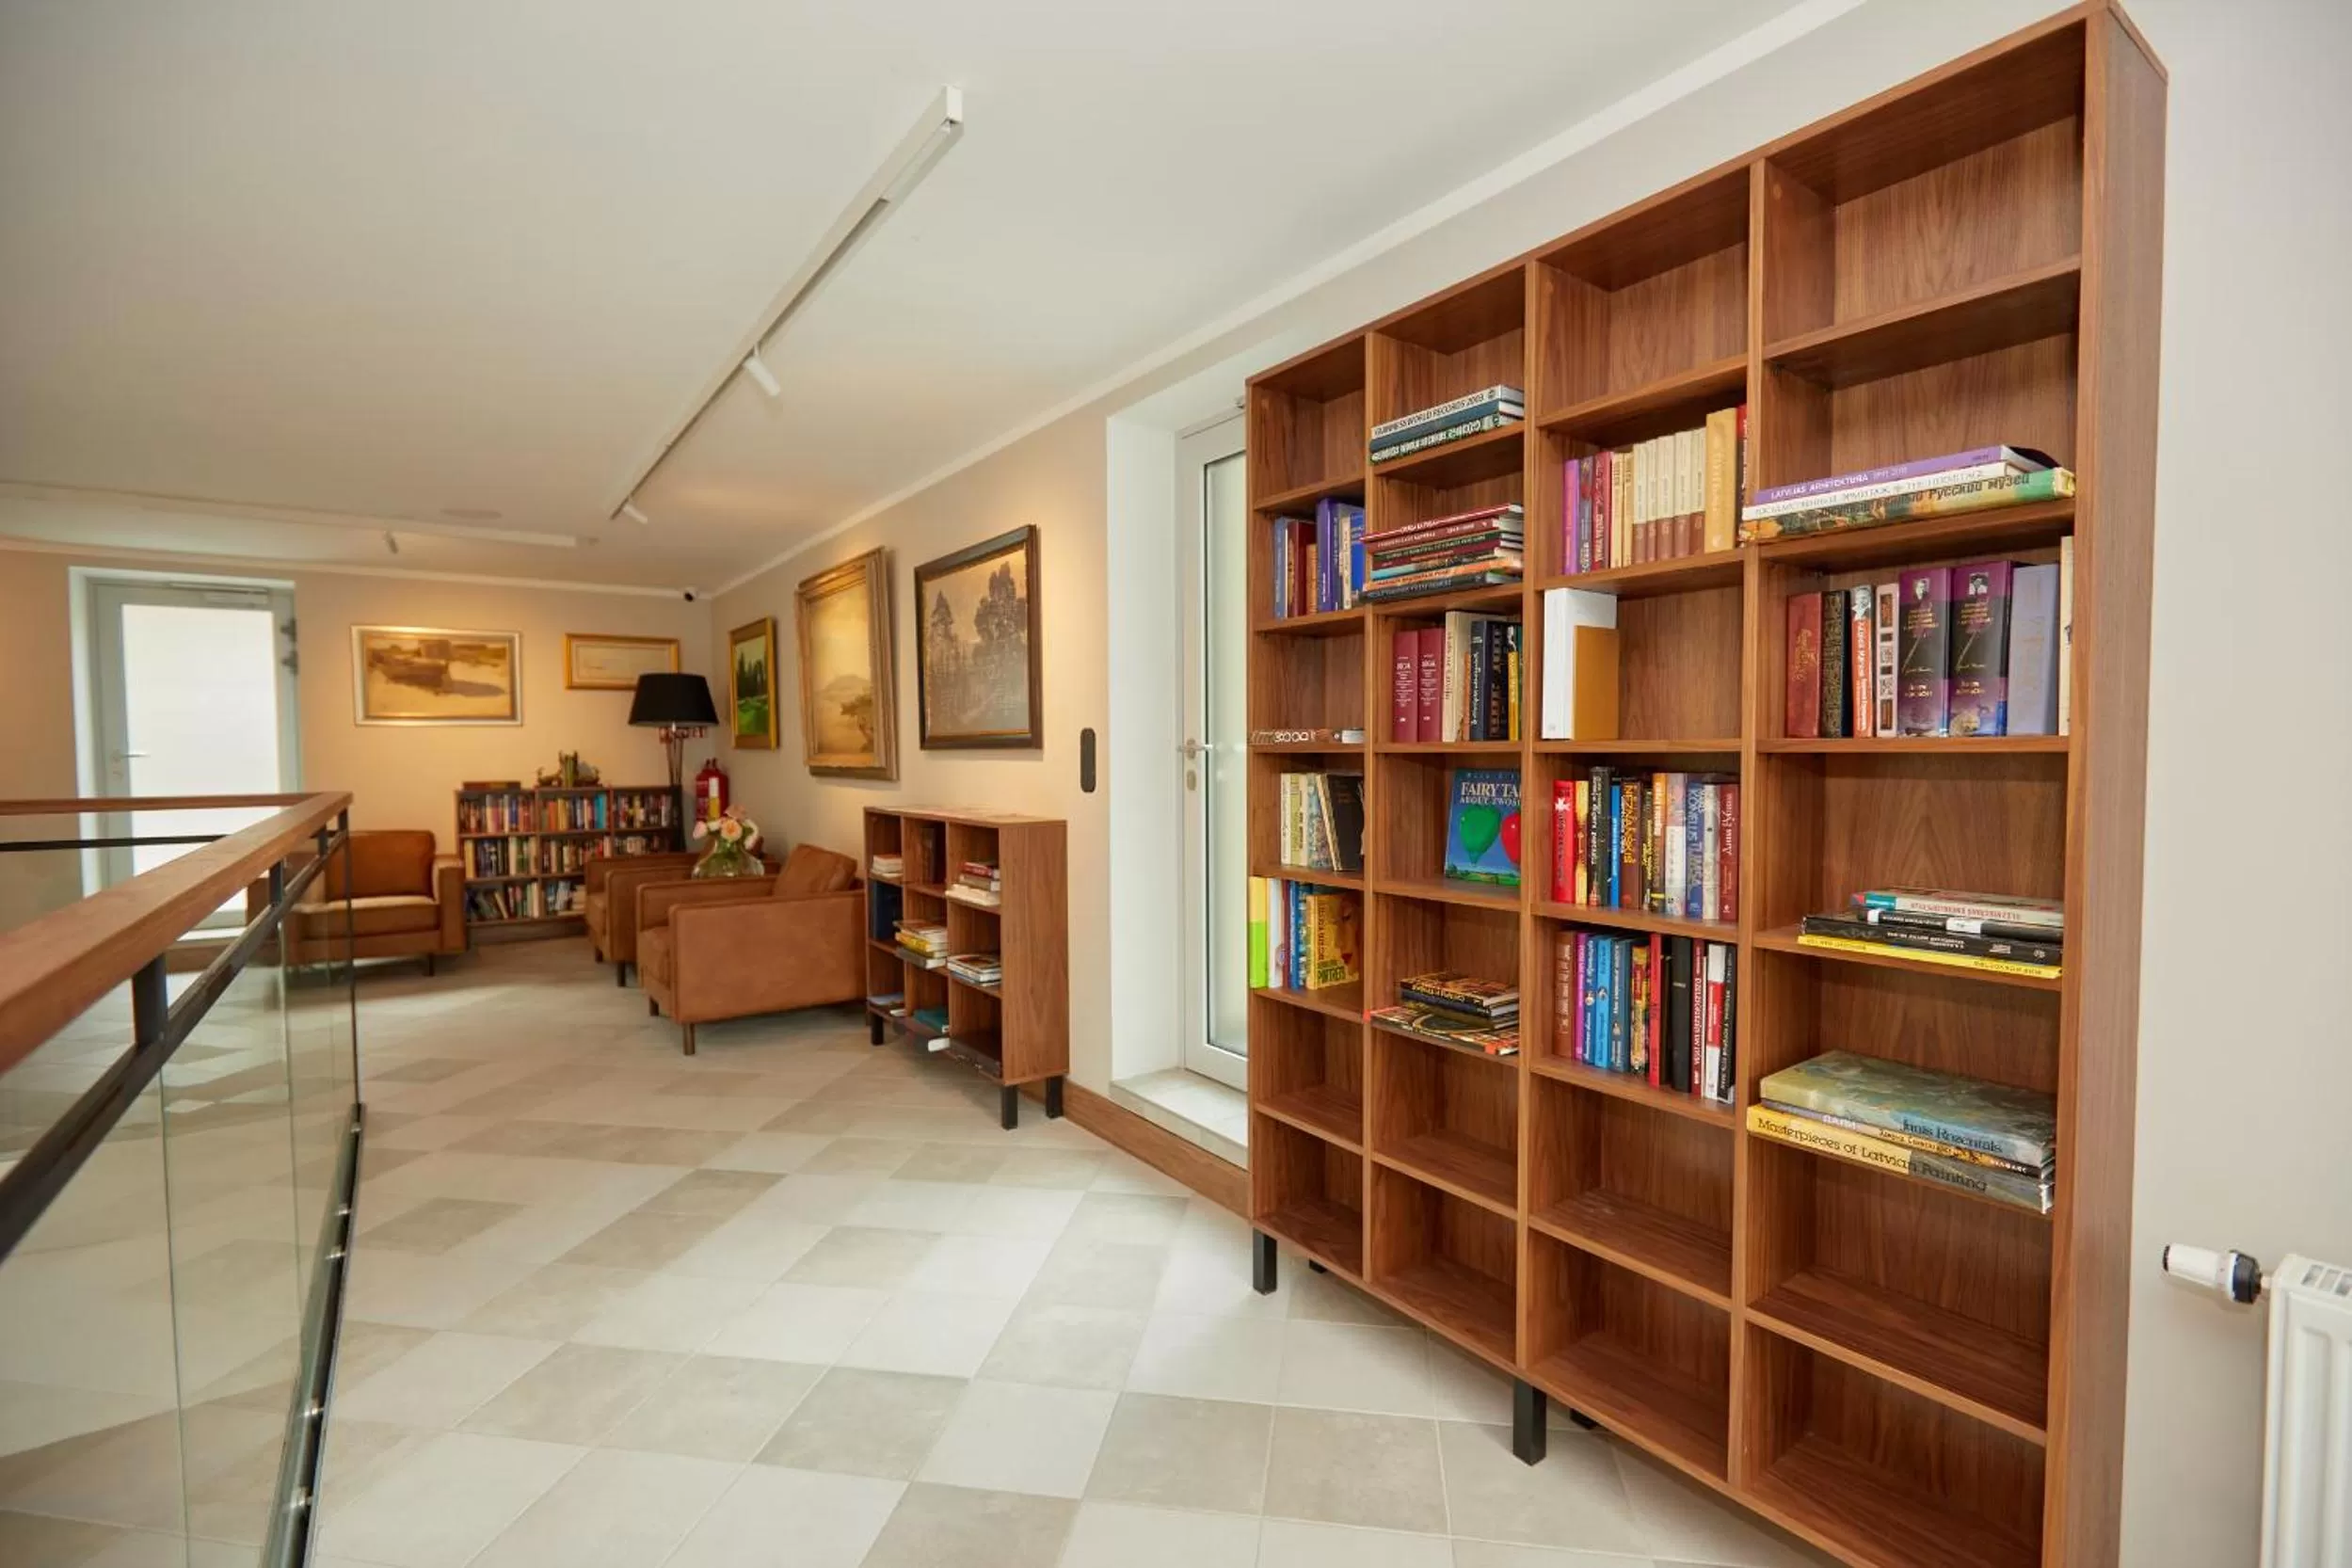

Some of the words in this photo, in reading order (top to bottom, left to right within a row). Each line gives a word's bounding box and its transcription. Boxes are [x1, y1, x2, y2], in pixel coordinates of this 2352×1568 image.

[1407, 410, 1432, 424] WORLD
[1432, 401, 1465, 416] RECORDS
[1770, 485, 1806, 501] LATVIJAS
[1929, 480, 1983, 500] Русский
[1987, 472, 2030, 489] музей
[1757, 1117, 1841, 1149] Masterpieces
[1843, 1141, 1858, 1155] of
[1862, 1146, 1917, 1173] Latvian
[1921, 1161, 1988, 1192] Painting
